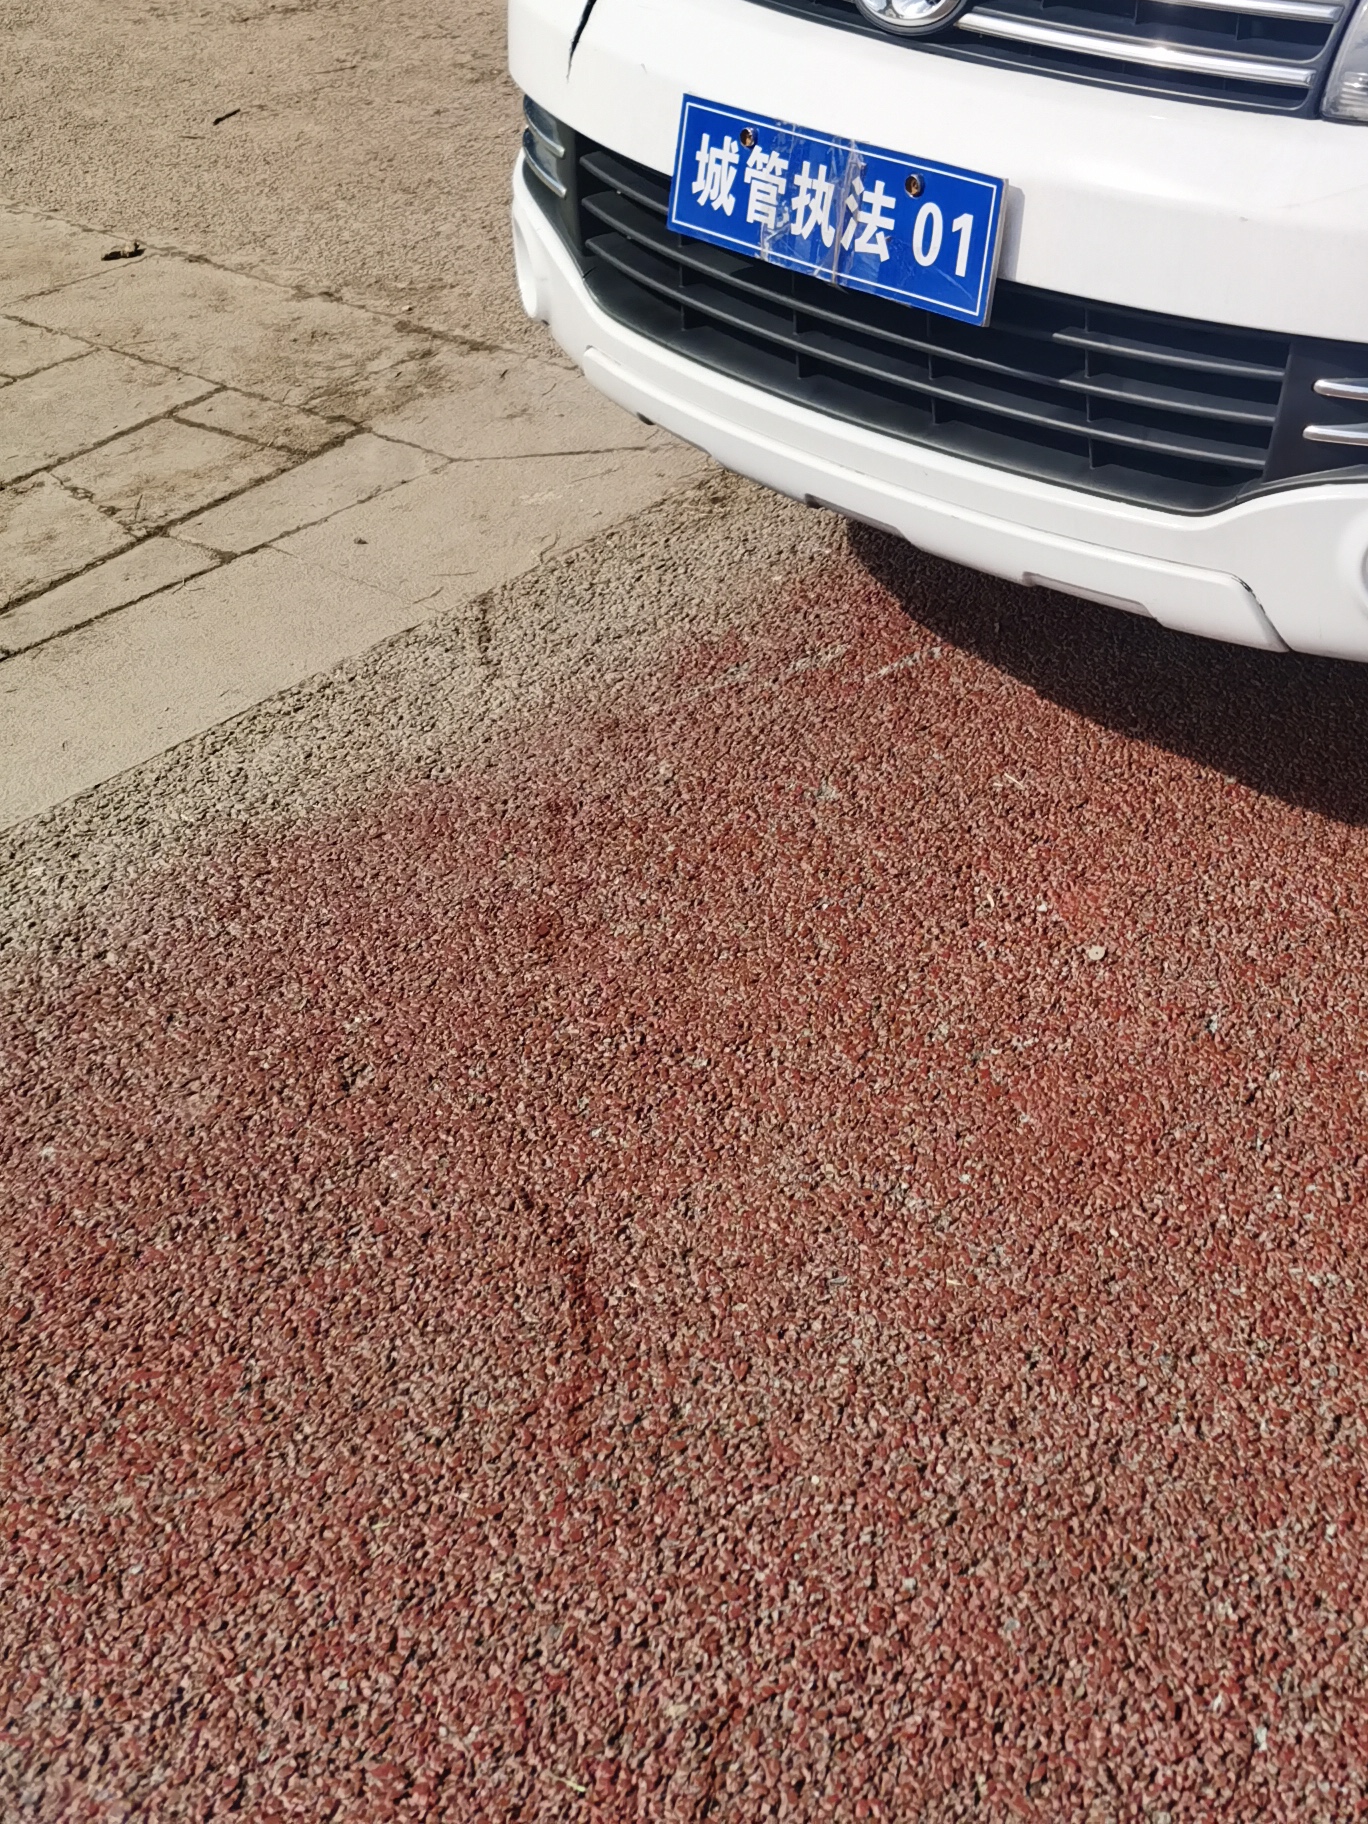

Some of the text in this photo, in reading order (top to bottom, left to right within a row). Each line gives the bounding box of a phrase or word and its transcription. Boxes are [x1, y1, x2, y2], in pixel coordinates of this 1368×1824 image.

[691, 132, 974, 277] 城管执法 01
